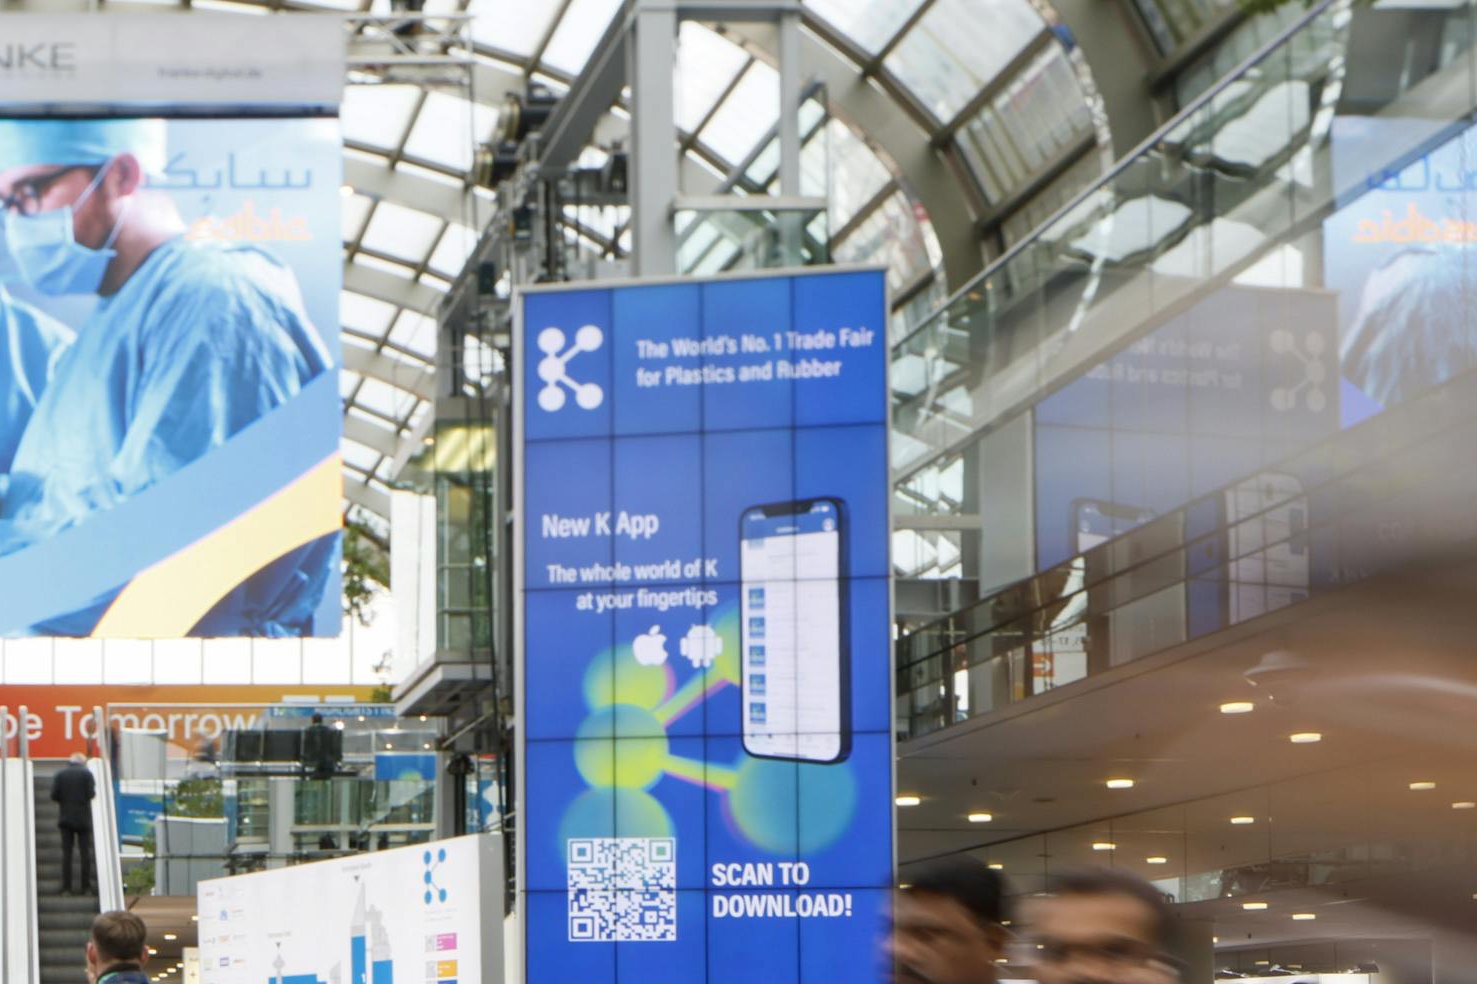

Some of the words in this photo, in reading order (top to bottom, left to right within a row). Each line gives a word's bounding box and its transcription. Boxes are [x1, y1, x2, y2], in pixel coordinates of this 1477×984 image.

[636, 339, 668, 358] The
[671, 335, 738, 357] World's
[741, 333, 771, 353] No.
[773, 332, 782, 350] 1
[786, 329, 836, 350] Trade
[839, 326, 874, 347] Fair
[636, 367, 662, 387] for
[665, 364, 735, 385] Plastics
[738, 360, 773, 382] and
[777, 357, 842, 379] Rubber
[542, 514, 591, 538] New
[595, 511, 611, 536] K
[615, 510, 660, 540] App
[547, 564, 577, 583] The
[580, 562, 631, 582] whole
[634, 560, 681, 580] world
[684, 558, 702, 579] of
[704, 558, 718, 577] K
[576, 592, 594, 611] at
[596, 593, 635, 614] your
[637, 587, 718, 612] fingertips
[55, 705, 258, 740] Tomorrow
[712, 862, 774, 886] SCAN
[779, 862, 810, 885] TO
[712, 894, 853, 918] DOWNLOAD!
